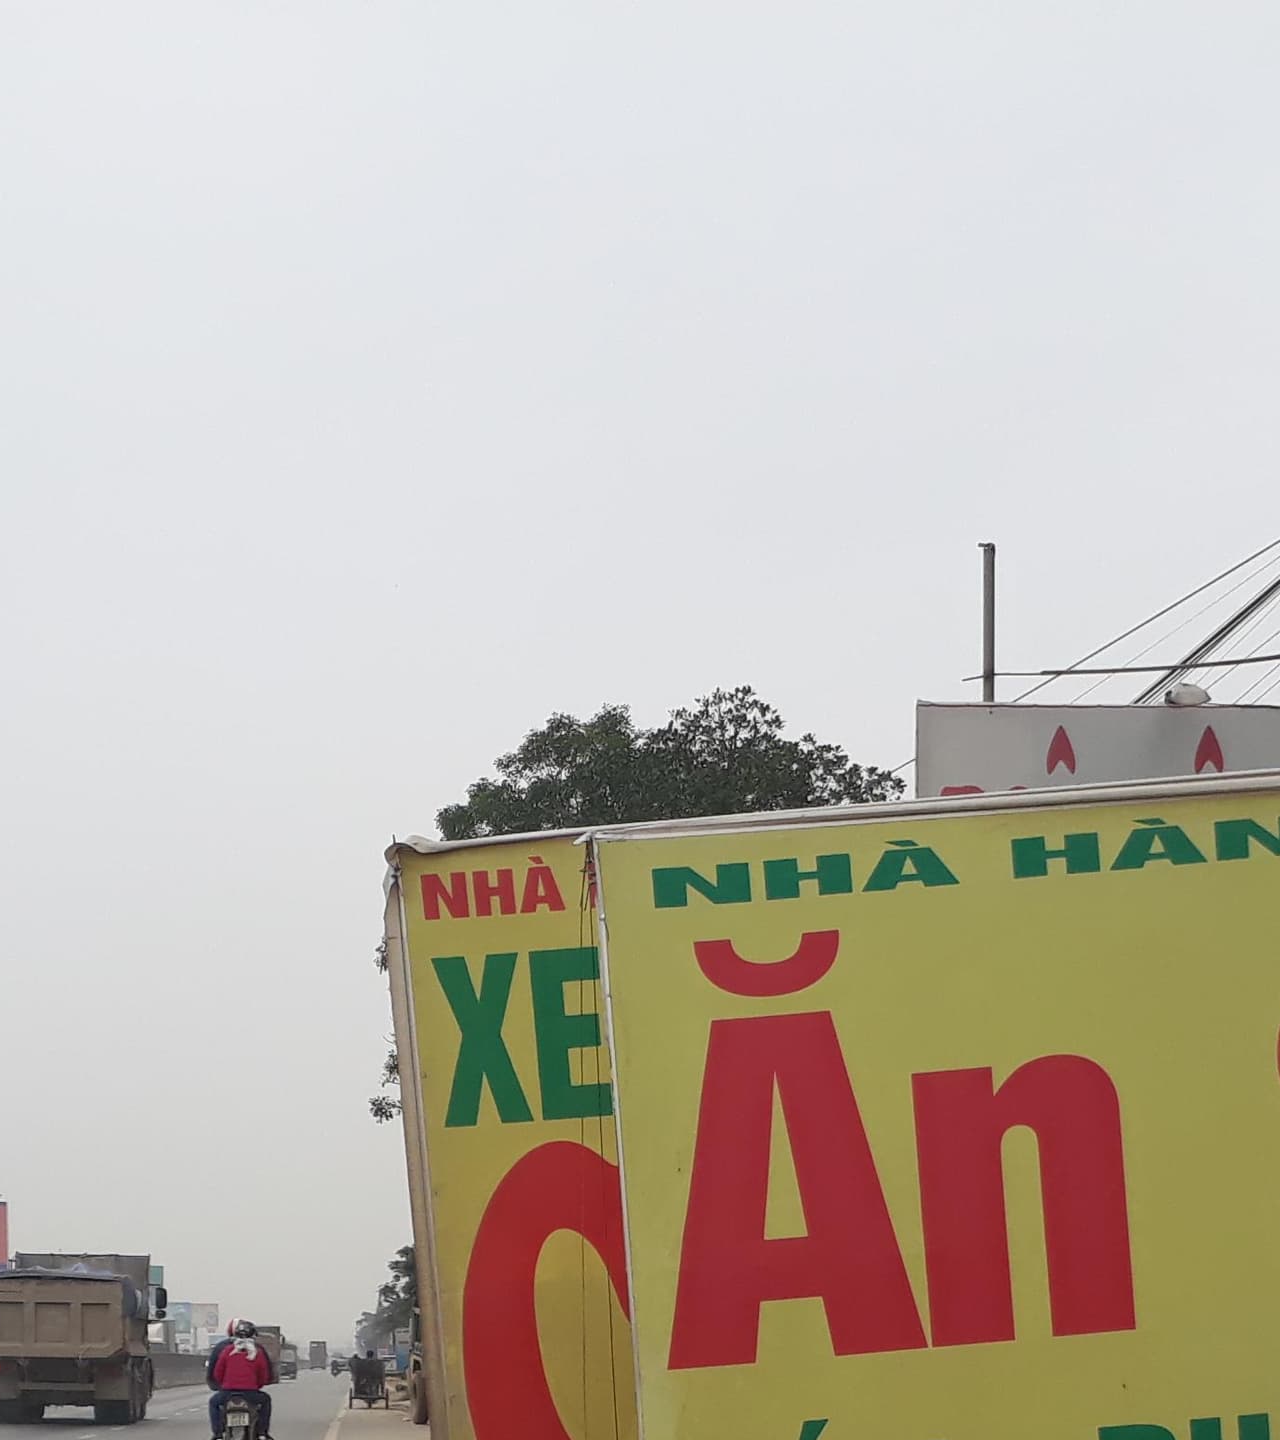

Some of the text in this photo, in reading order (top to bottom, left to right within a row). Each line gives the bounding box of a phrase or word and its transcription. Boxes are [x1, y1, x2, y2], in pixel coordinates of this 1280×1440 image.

[420, 855, 566, 921] NHÀ
[651, 838, 961, 909] NHÀ
[430, 946, 614, 1129] XE
[667, 929, 1138, 1371] Ăn
